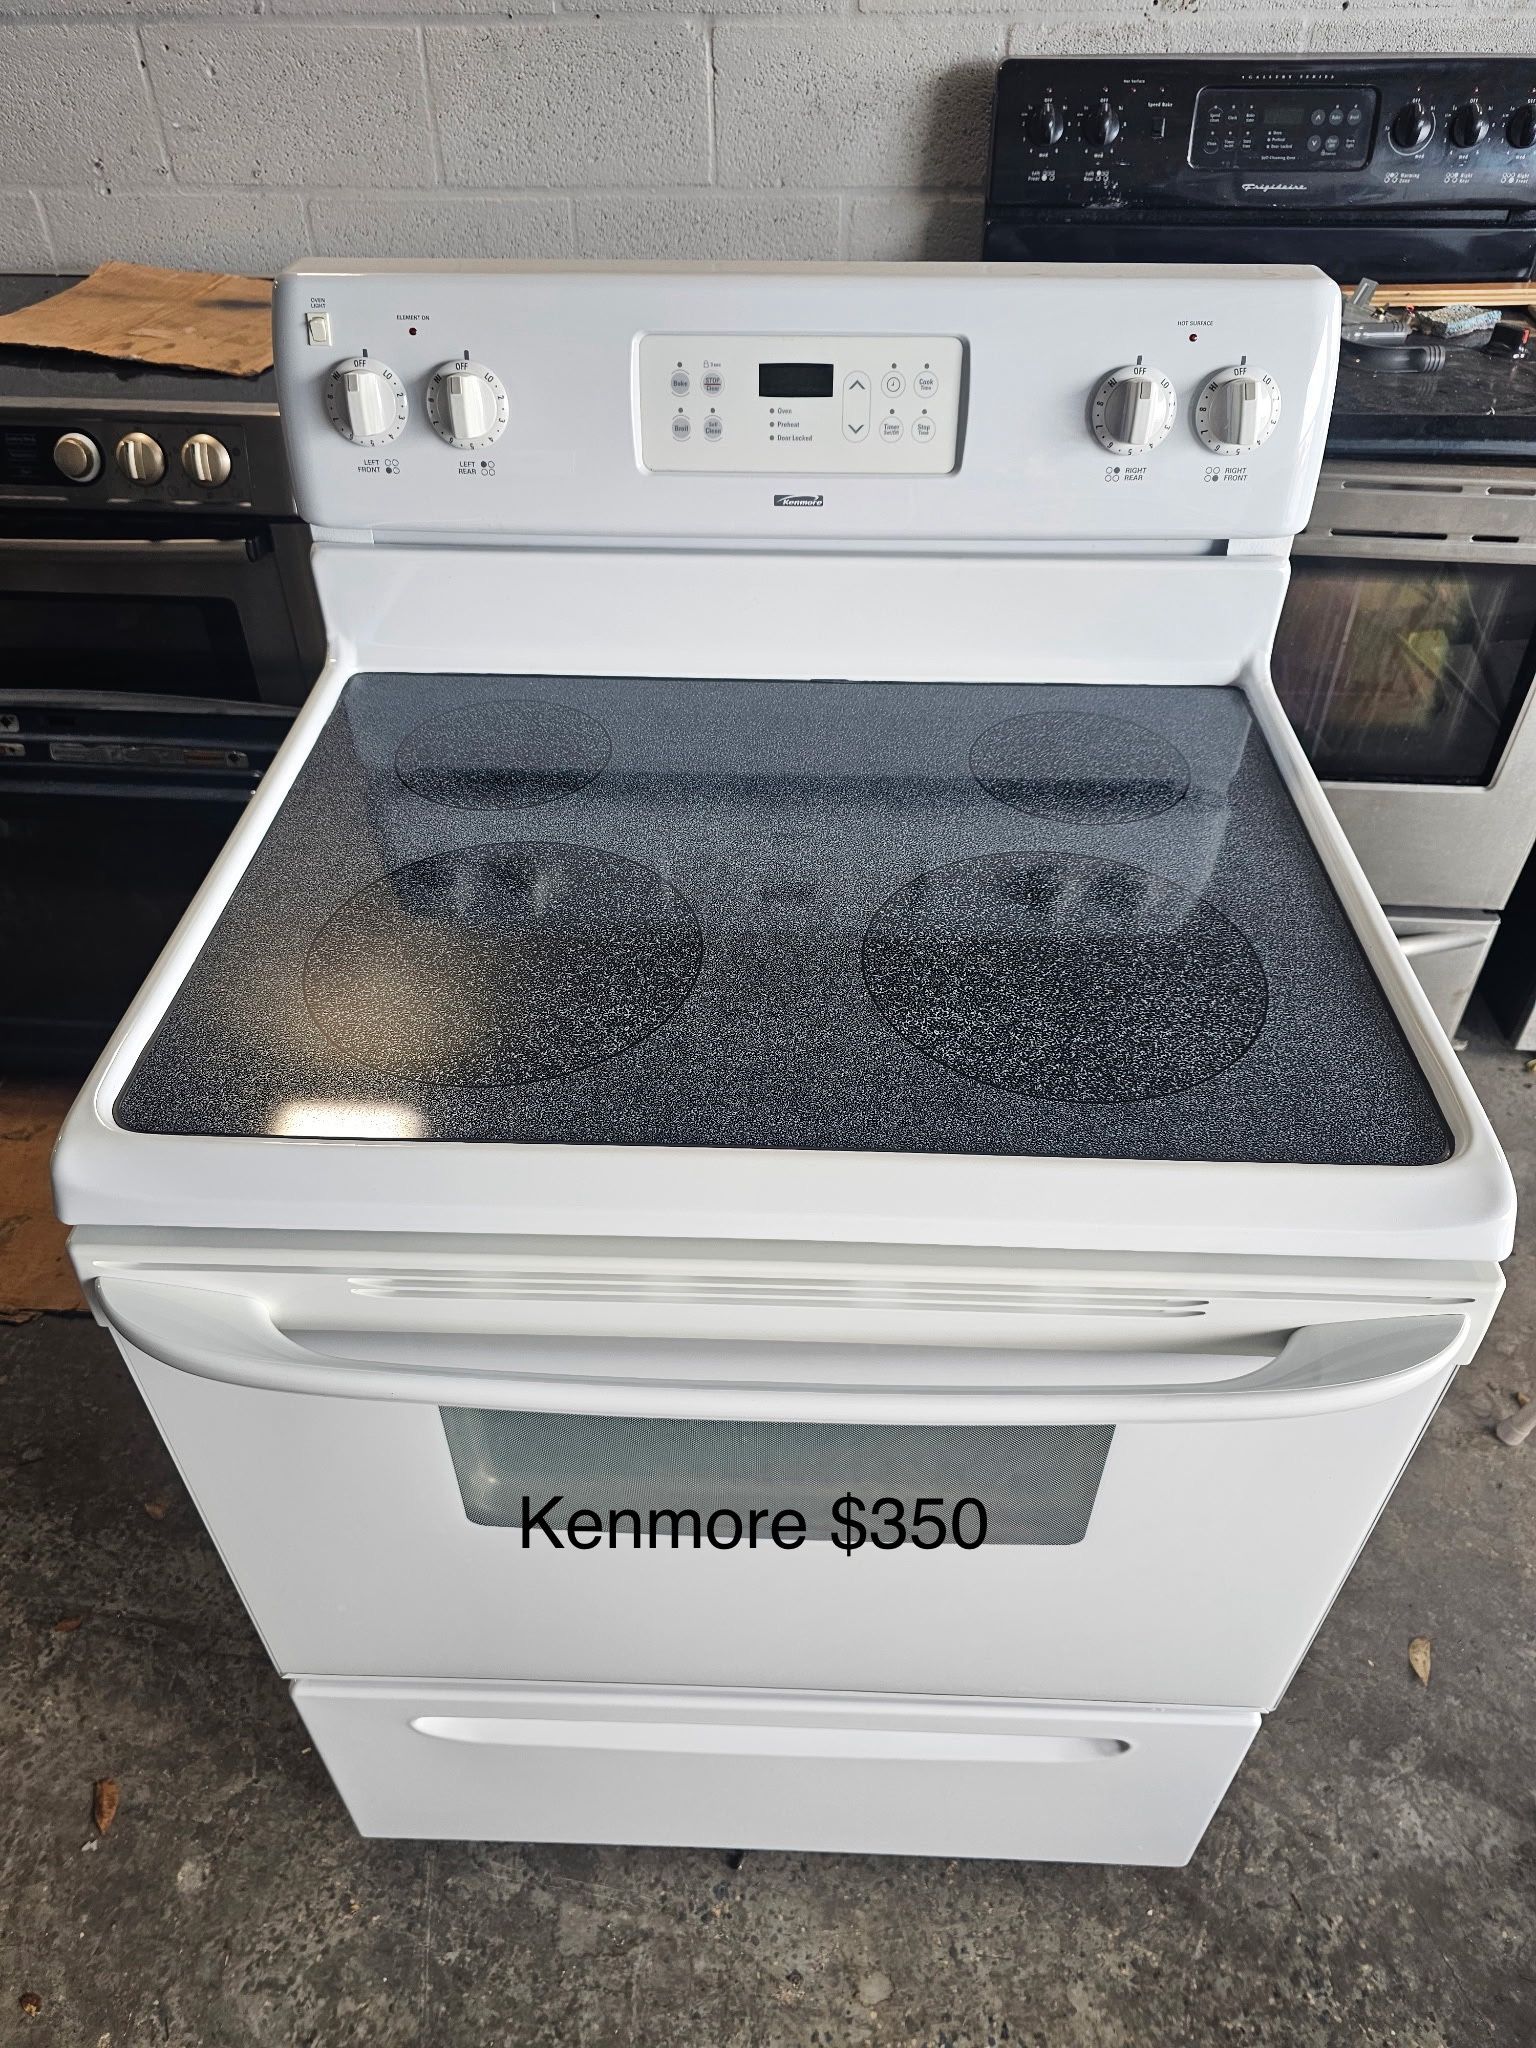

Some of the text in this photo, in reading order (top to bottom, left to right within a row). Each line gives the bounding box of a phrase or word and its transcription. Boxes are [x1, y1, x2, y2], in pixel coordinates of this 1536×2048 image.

[1242, 183, 1308, 192] Frigidaire
[353, 360, 367, 368] OFF
[455, 363, 469, 371] OFF
[332, 371, 342, 381] HI
[383, 370, 393, 380] LO
[1133, 368, 1147, 376] OFF
[1233, 367, 1247, 376] OFF
[433, 374, 443, 384] HI
[484, 372, 494, 383] LO
[1262, 374, 1272, 385] LO
[1107, 377, 1118, 388] HI
[1160, 378, 1170, 389] LO
[1208, 381, 1219, 392] HI
[777, 407, 793, 415] Oven
[777, 421, 800, 429] Preheat
[917, 424, 931, 432] Stop
[792, 434, 813, 442] Locked
[782, 498, 823, 506] Kenmore
